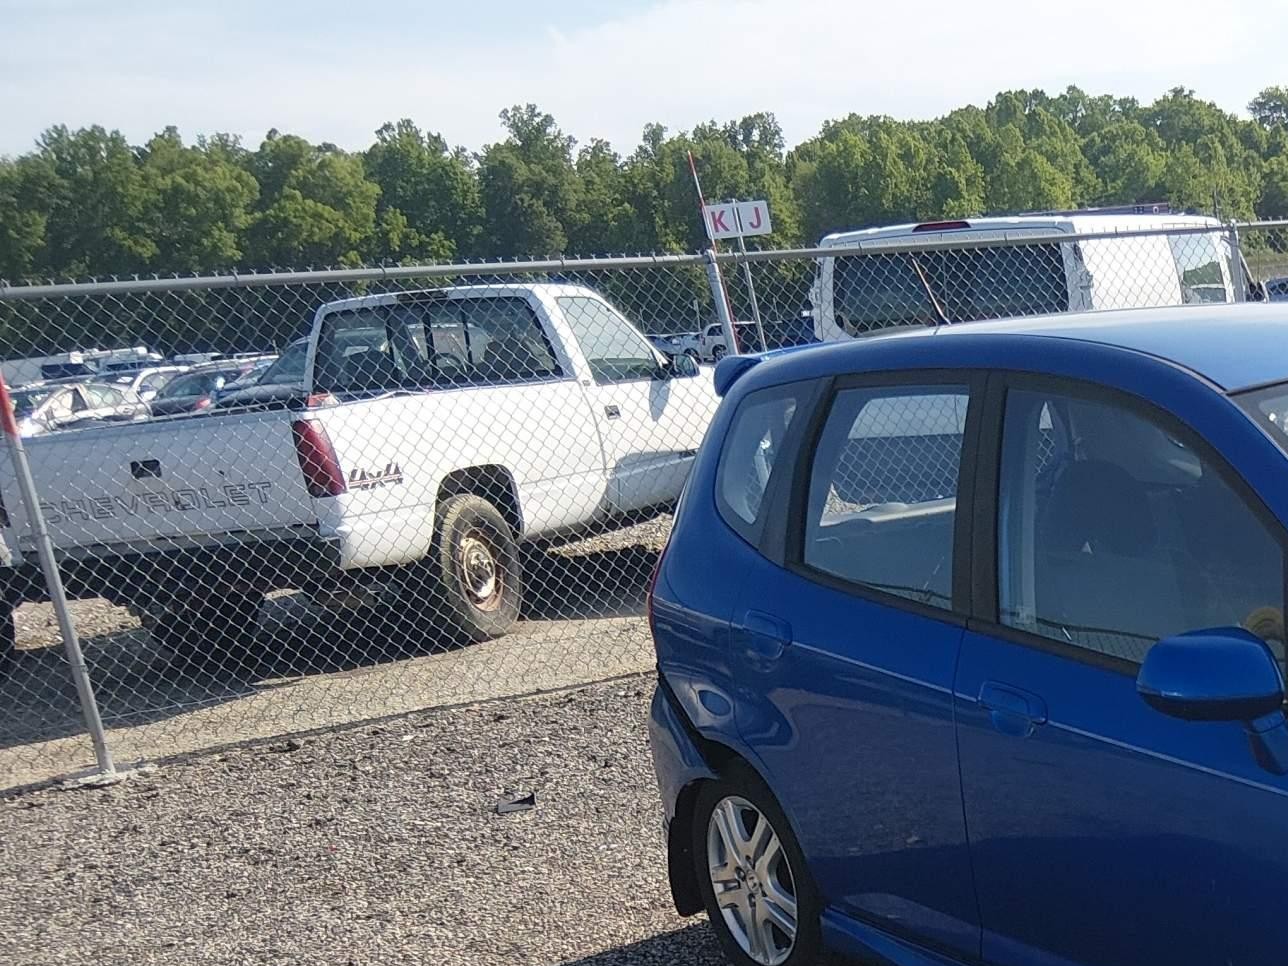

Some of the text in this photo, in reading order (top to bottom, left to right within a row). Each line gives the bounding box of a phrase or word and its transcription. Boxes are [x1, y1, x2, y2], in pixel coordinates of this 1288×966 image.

[711, 206, 762, 233] K J
[349, 462, 404, 491] 4x4
[38, 481, 272, 524] CHEVROLET
